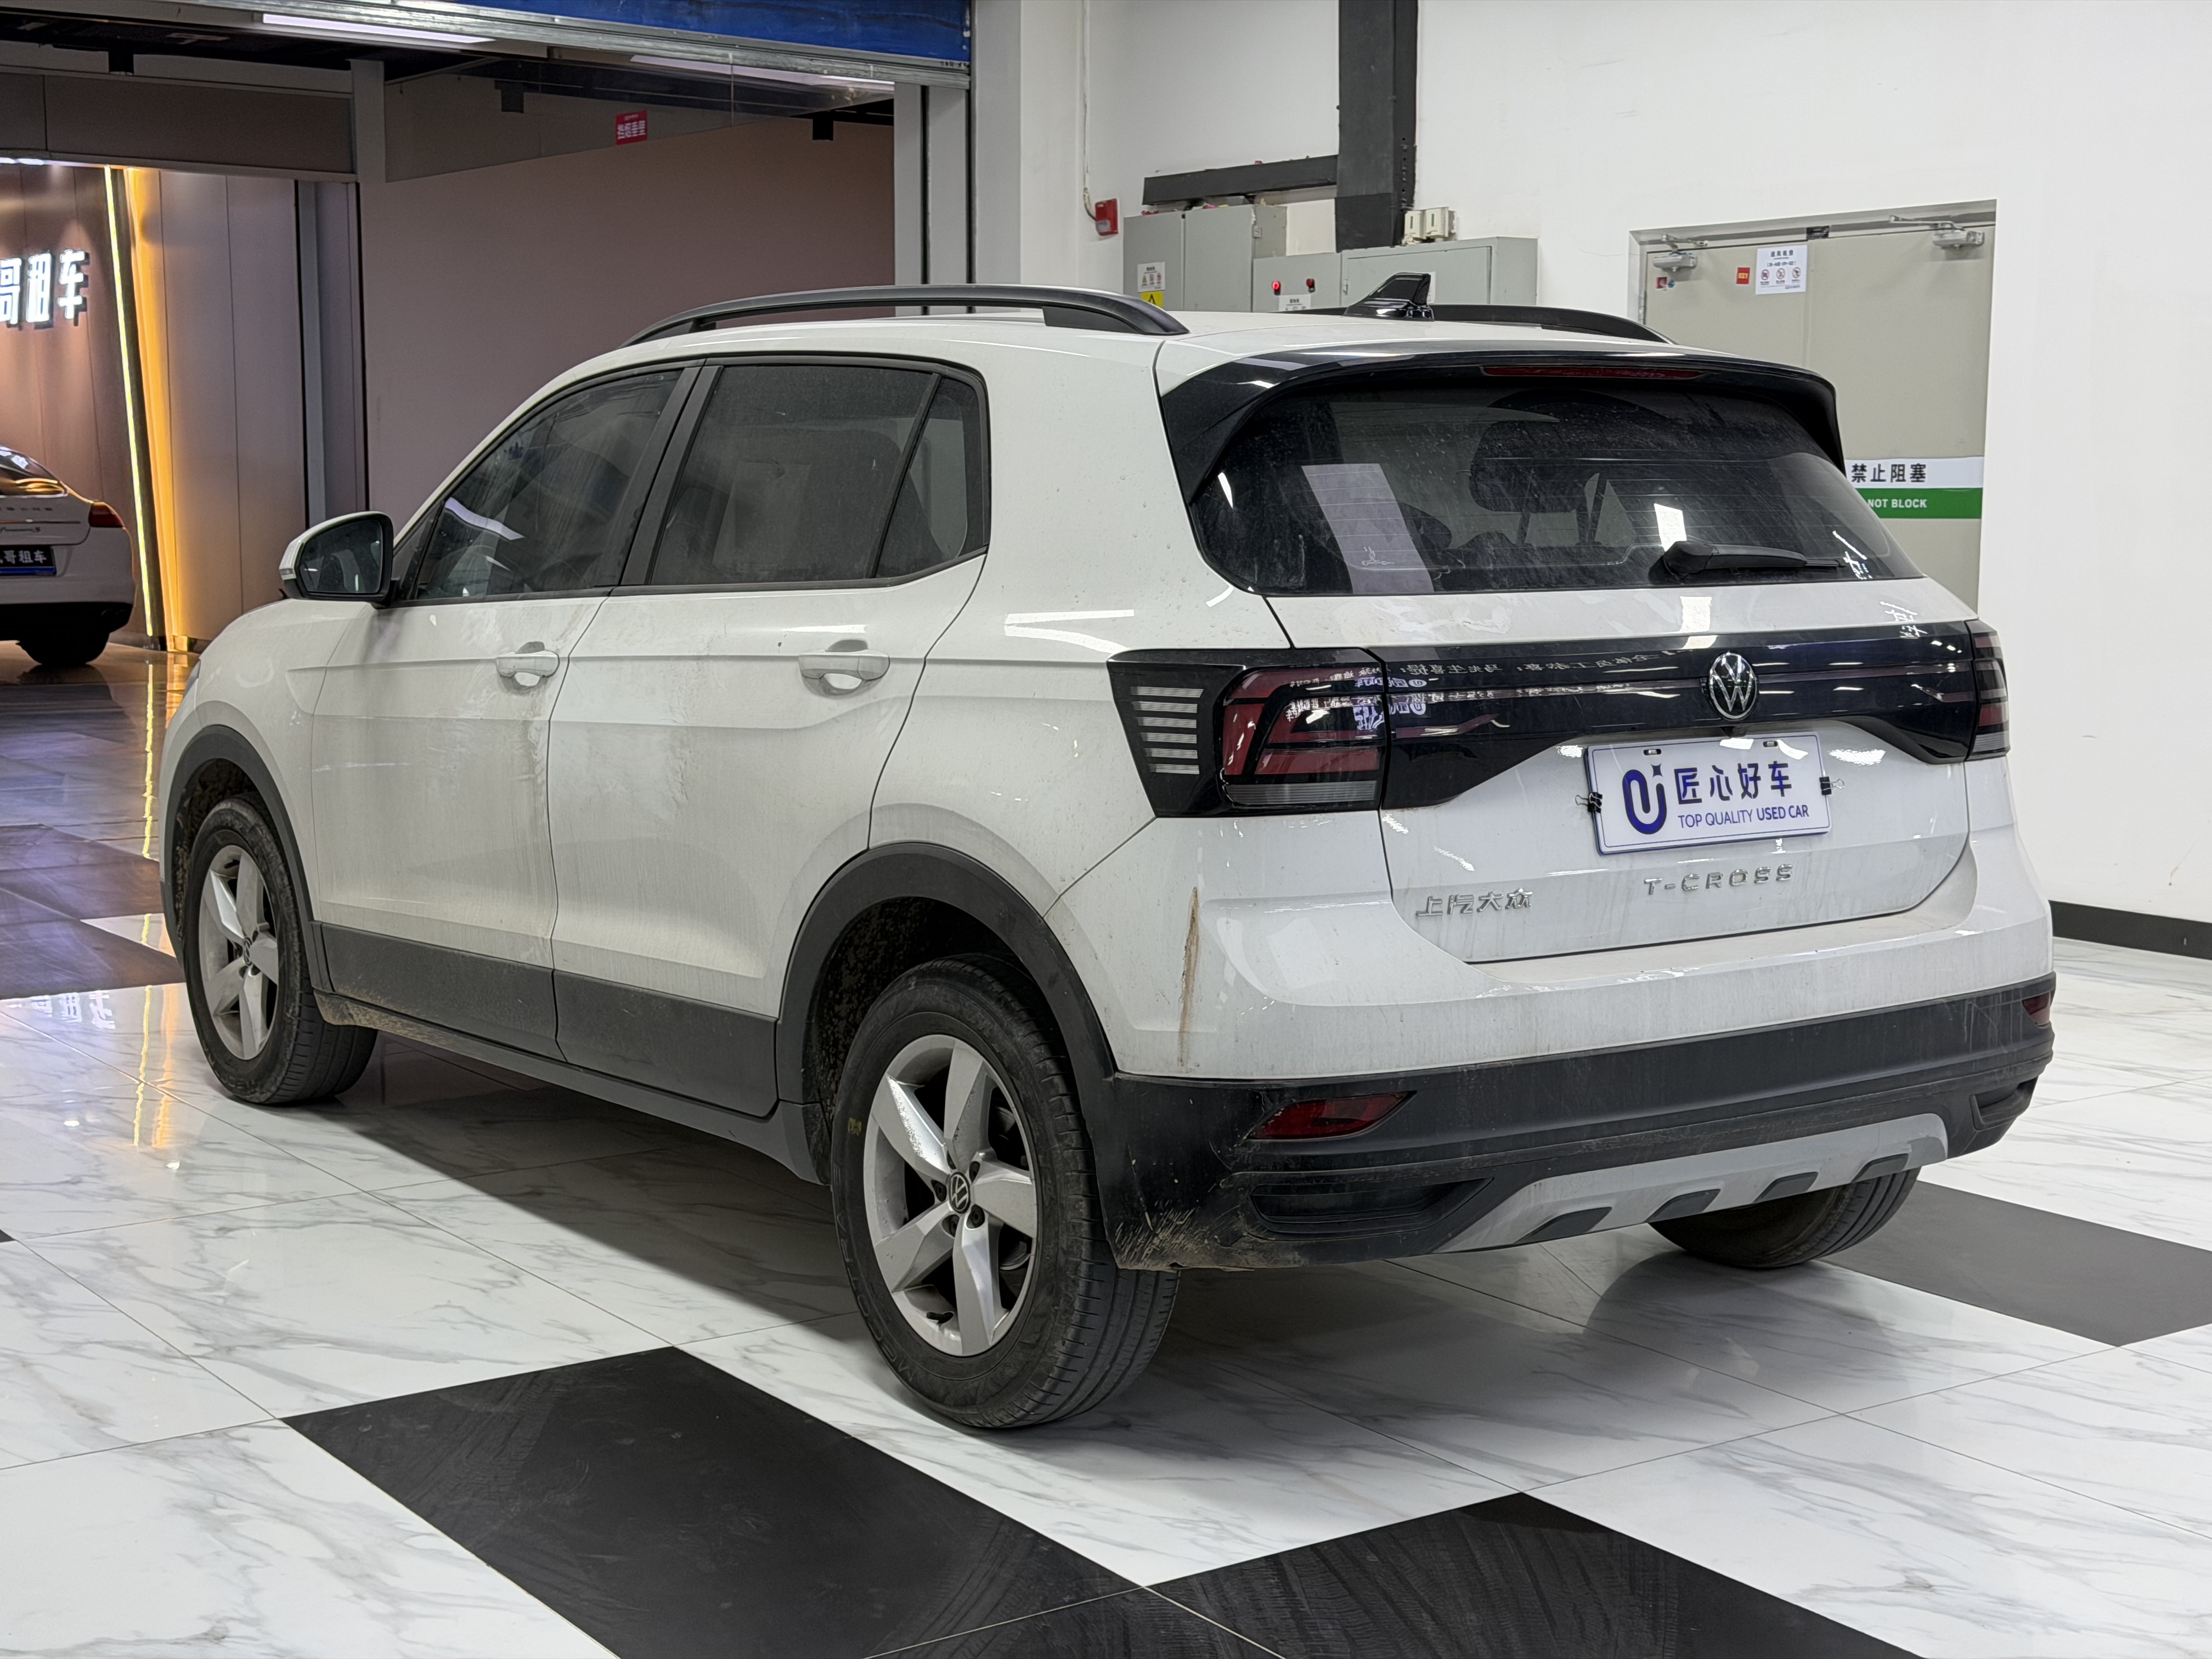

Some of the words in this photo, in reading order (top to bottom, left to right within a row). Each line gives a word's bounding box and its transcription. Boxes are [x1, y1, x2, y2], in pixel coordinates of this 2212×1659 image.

[1851, 463, 1926, 483] 禁止阻塞
[1891, 499, 1927, 508] BLOCK
[1674, 760, 1792, 805] 匠心好车
[1677, 814, 1702, 828] TOP
[1705, 809, 1753, 827] QUALITY
[1756, 806, 1786, 821] USED
[1788, 804, 1809, 819] CAR
[1644, 864, 1793, 895] T-CROSS
[1415, 887, 1533, 918] 上汽大众
